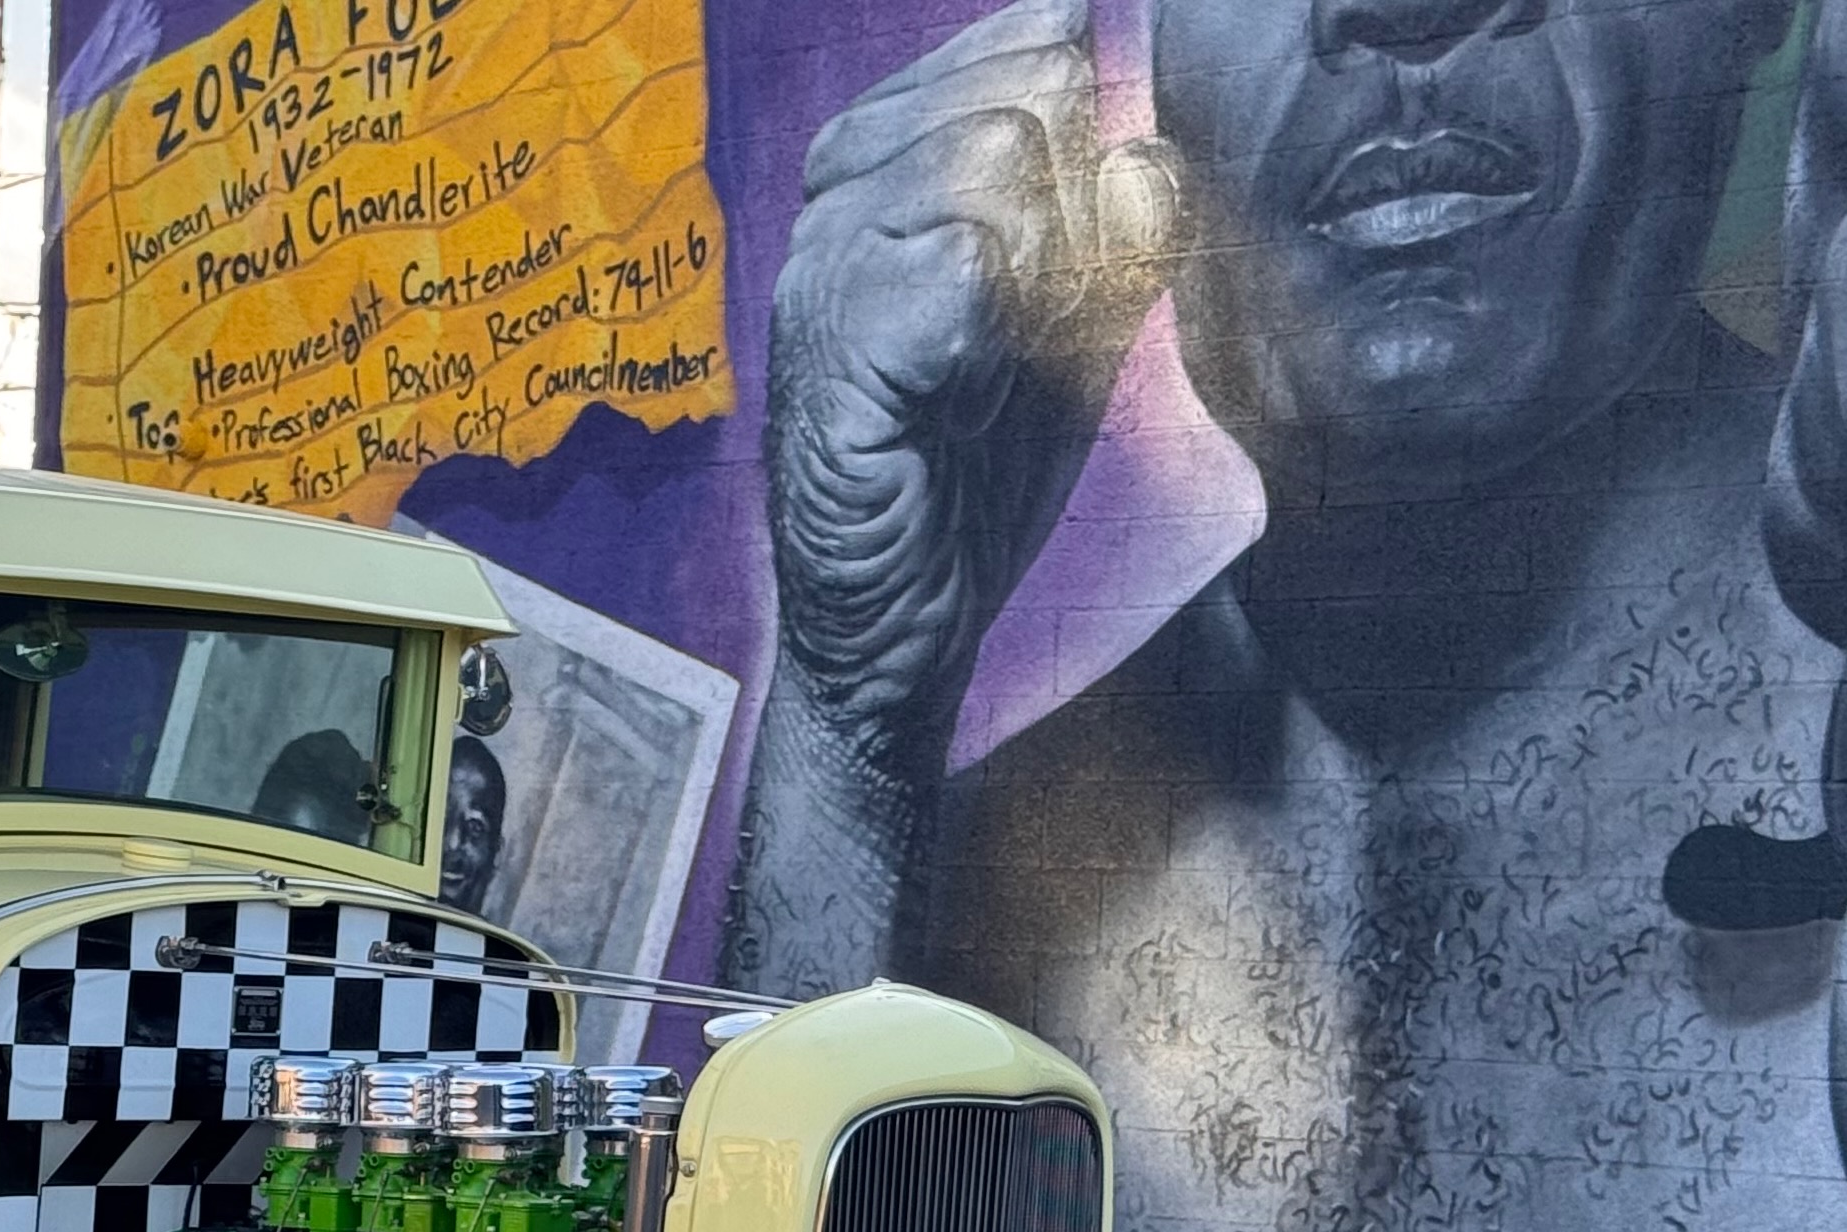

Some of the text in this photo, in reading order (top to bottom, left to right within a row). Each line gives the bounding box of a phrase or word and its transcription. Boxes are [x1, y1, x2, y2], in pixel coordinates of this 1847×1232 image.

[153, 5, 301, 160] ZORA
[249, 31, 454, 154] 1932-1972
[125, 110, 404, 279] Korean War Veteran
[197, 139, 537, 304] Proud Chandlerite
[192, 278, 384, 405] Heavyweight
[400, 223, 572, 307] Contender
[221, 220, 708, 452] Professional Boxing Record: 79-11-6
[289, 446, 350, 501] first
[357, 417, 438, 474] Black
[453, 385, 511, 458] City
[524, 330, 719, 406] Councilmember
